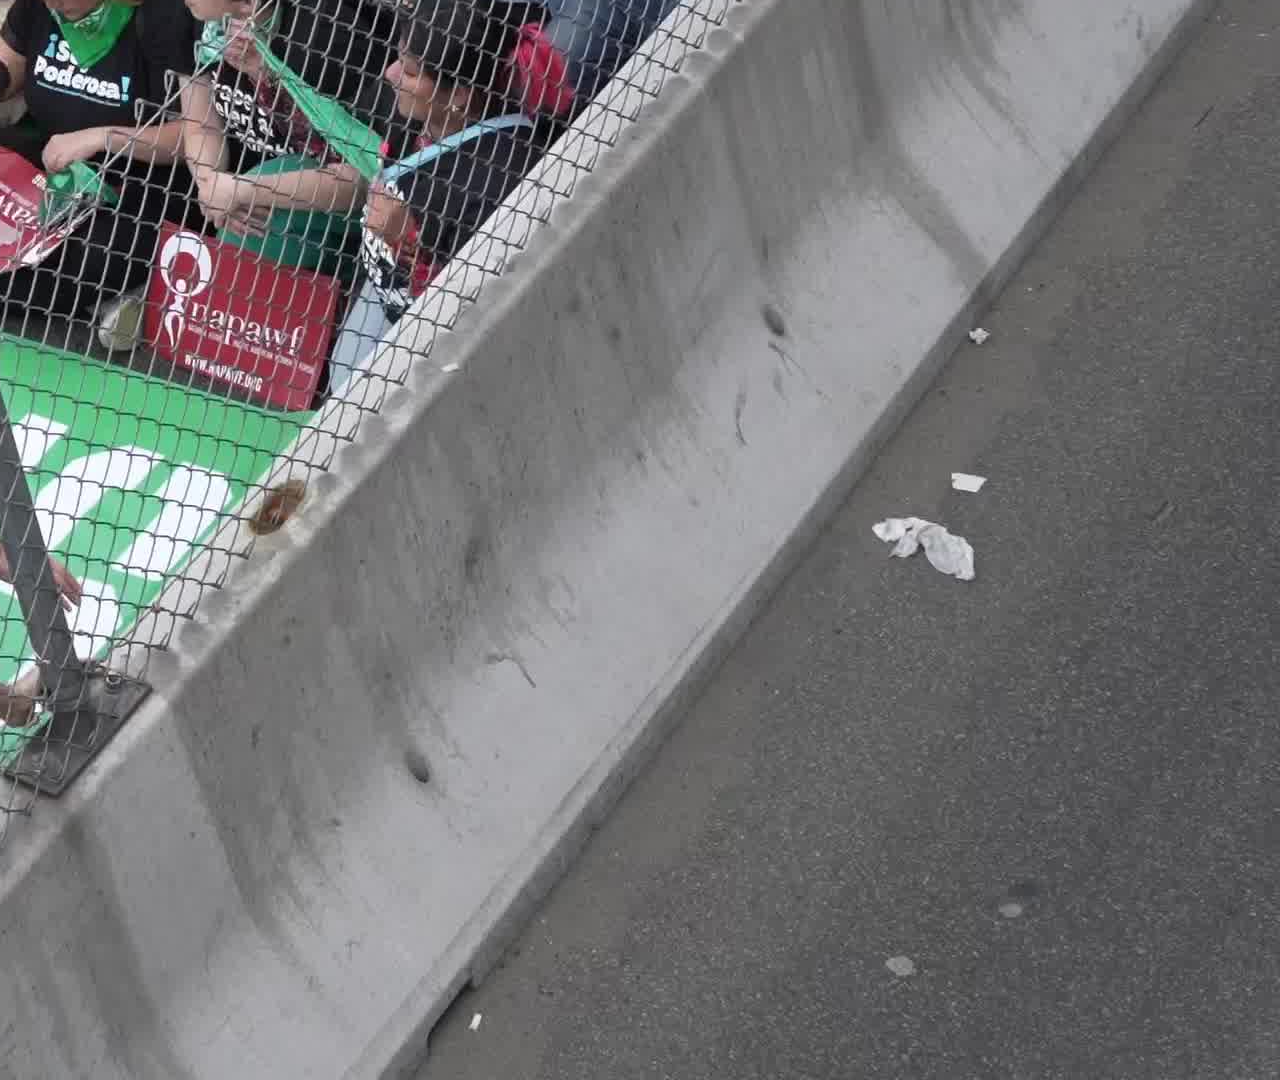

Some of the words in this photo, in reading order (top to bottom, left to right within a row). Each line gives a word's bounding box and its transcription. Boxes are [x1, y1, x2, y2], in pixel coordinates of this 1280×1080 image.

[33, 55, 131, 103] Poderosa!
[191, 301, 307, 356] napawf
[184, 353, 264, 393] WWW.NAPAWF.ORG
